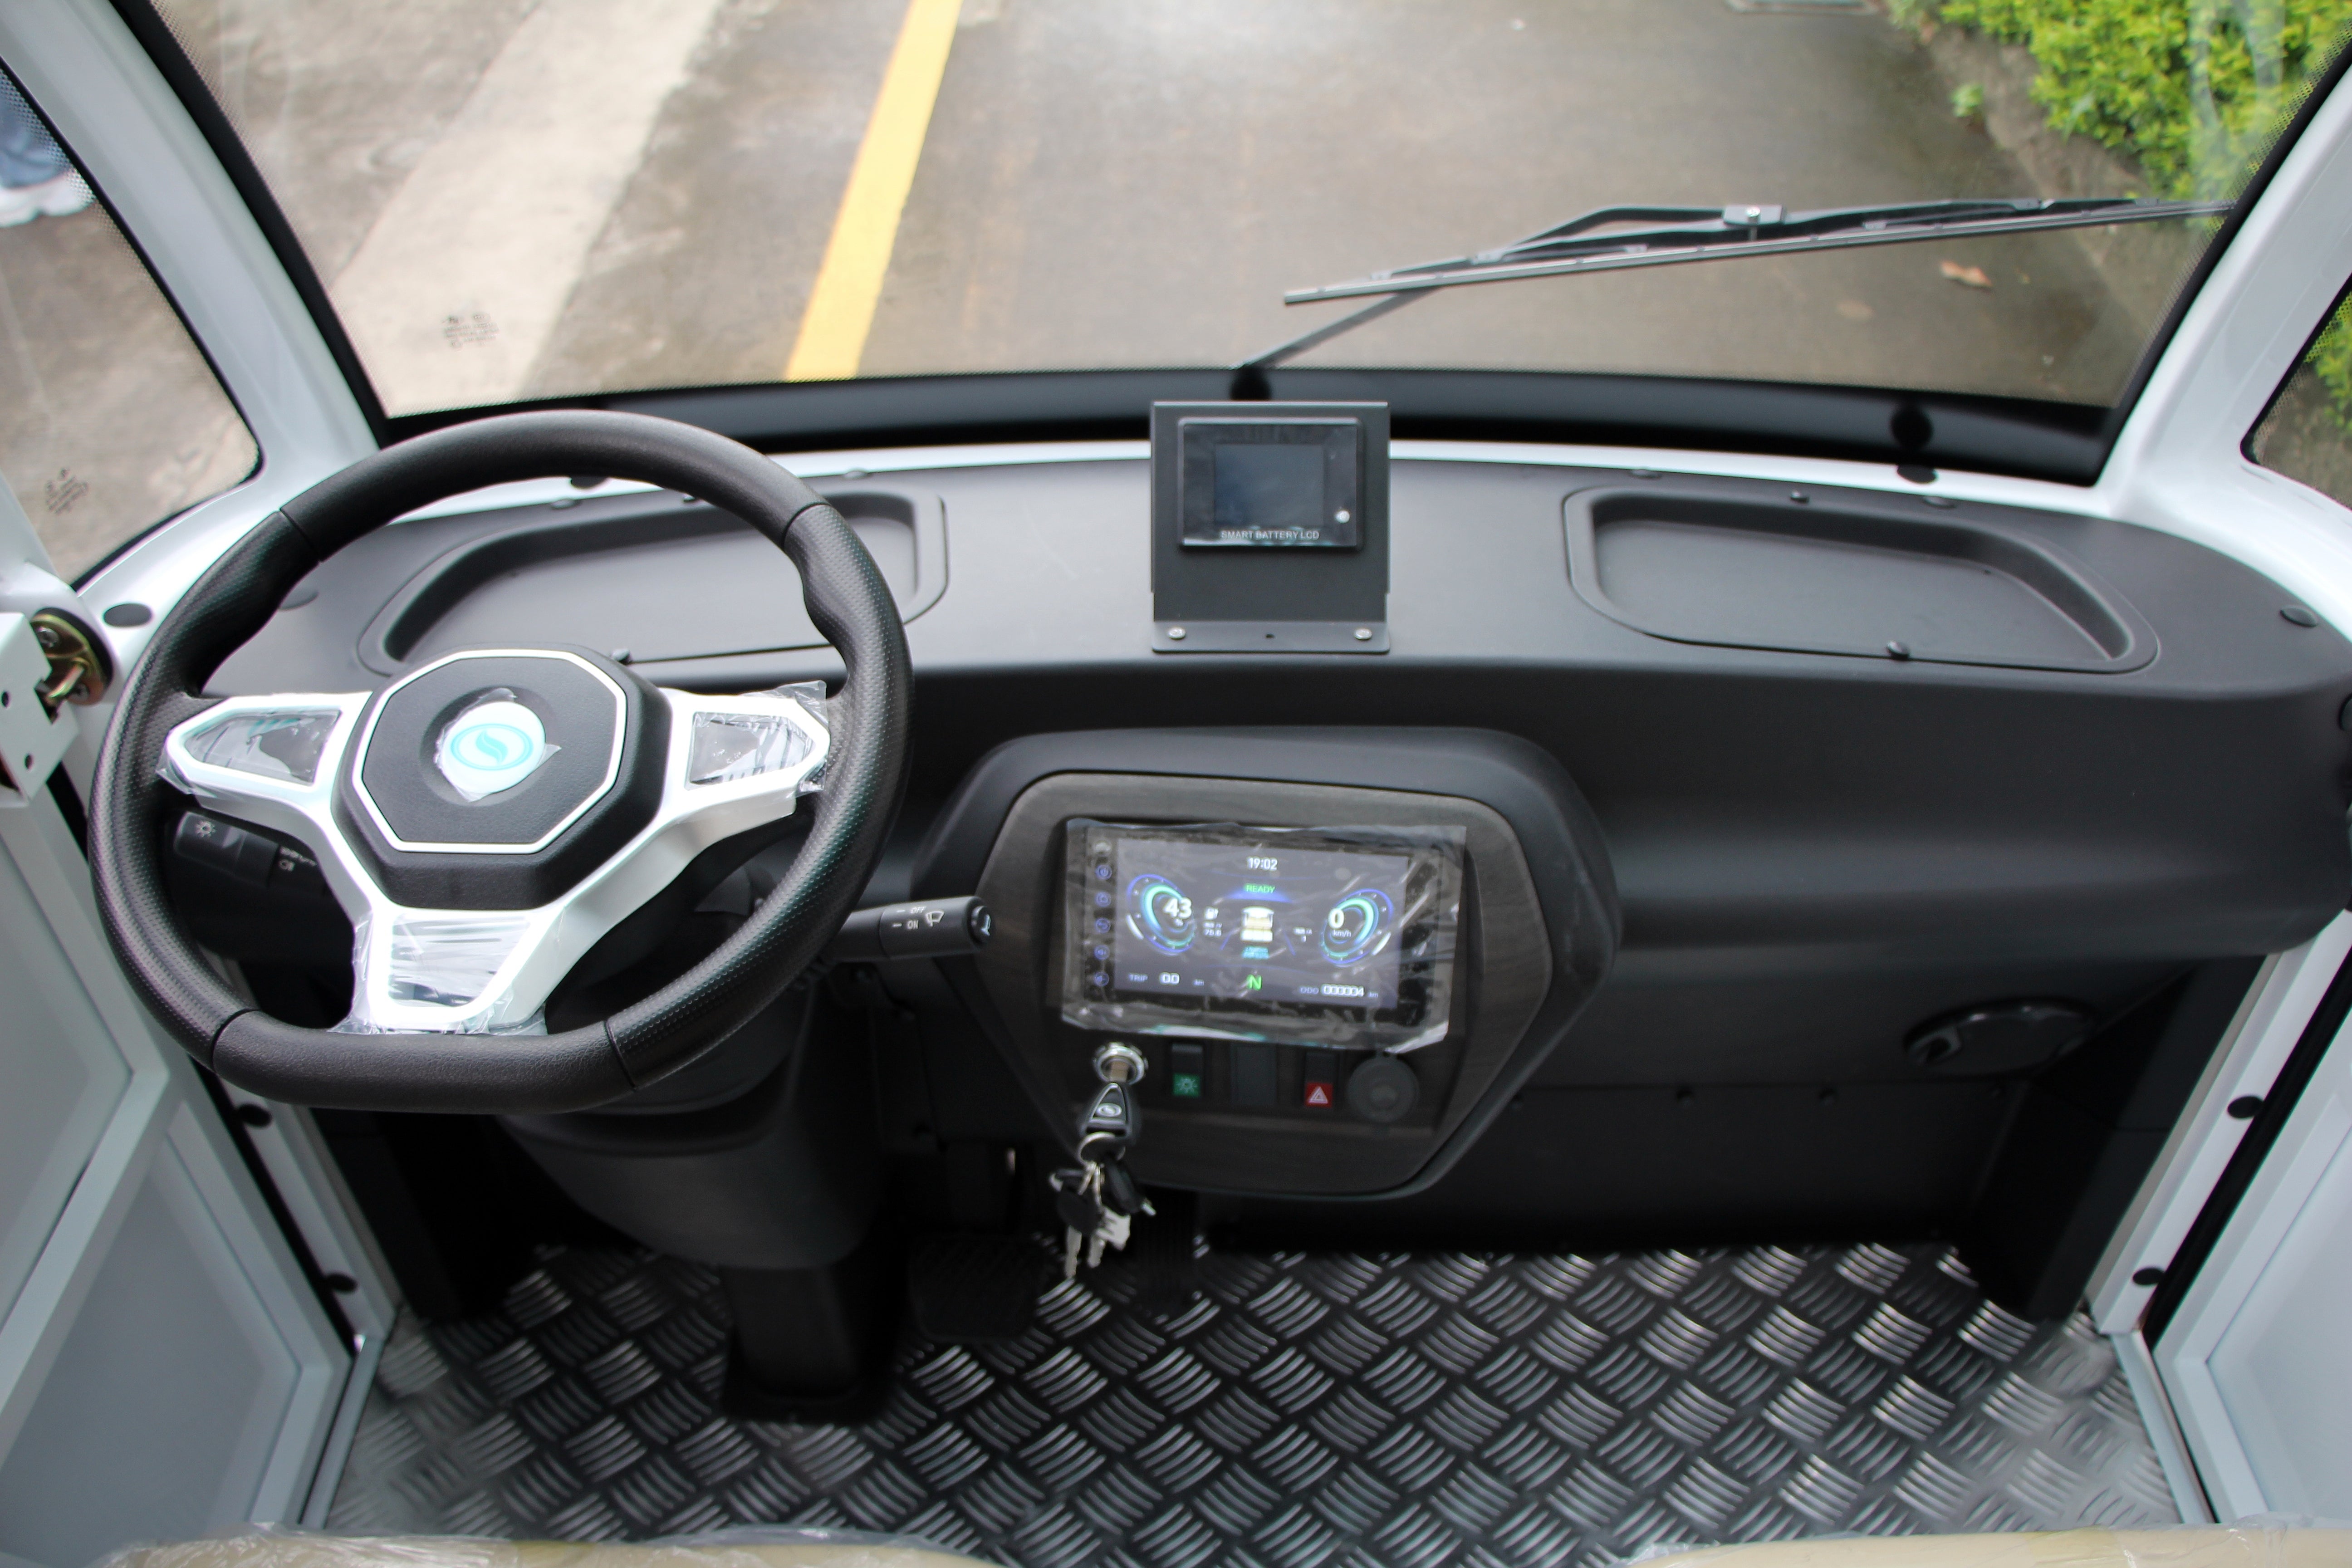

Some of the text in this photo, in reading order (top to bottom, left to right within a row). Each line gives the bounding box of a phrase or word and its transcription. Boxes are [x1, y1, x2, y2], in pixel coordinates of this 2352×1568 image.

[1221, 530, 1320, 540] SMART BATTERY LCD
[1248, 857, 1278, 871] 19:02
[1245, 883, 1275, 894] READY
[1163, 897, 1192, 919] 43
[1328, 908, 1345, 929] 0
[907, 920, 919, 930] ON
[1333, 930, 1352, 938] km/h
[1247, 974, 1262, 990] N
[1322, 985, 1364, 997] 000004
